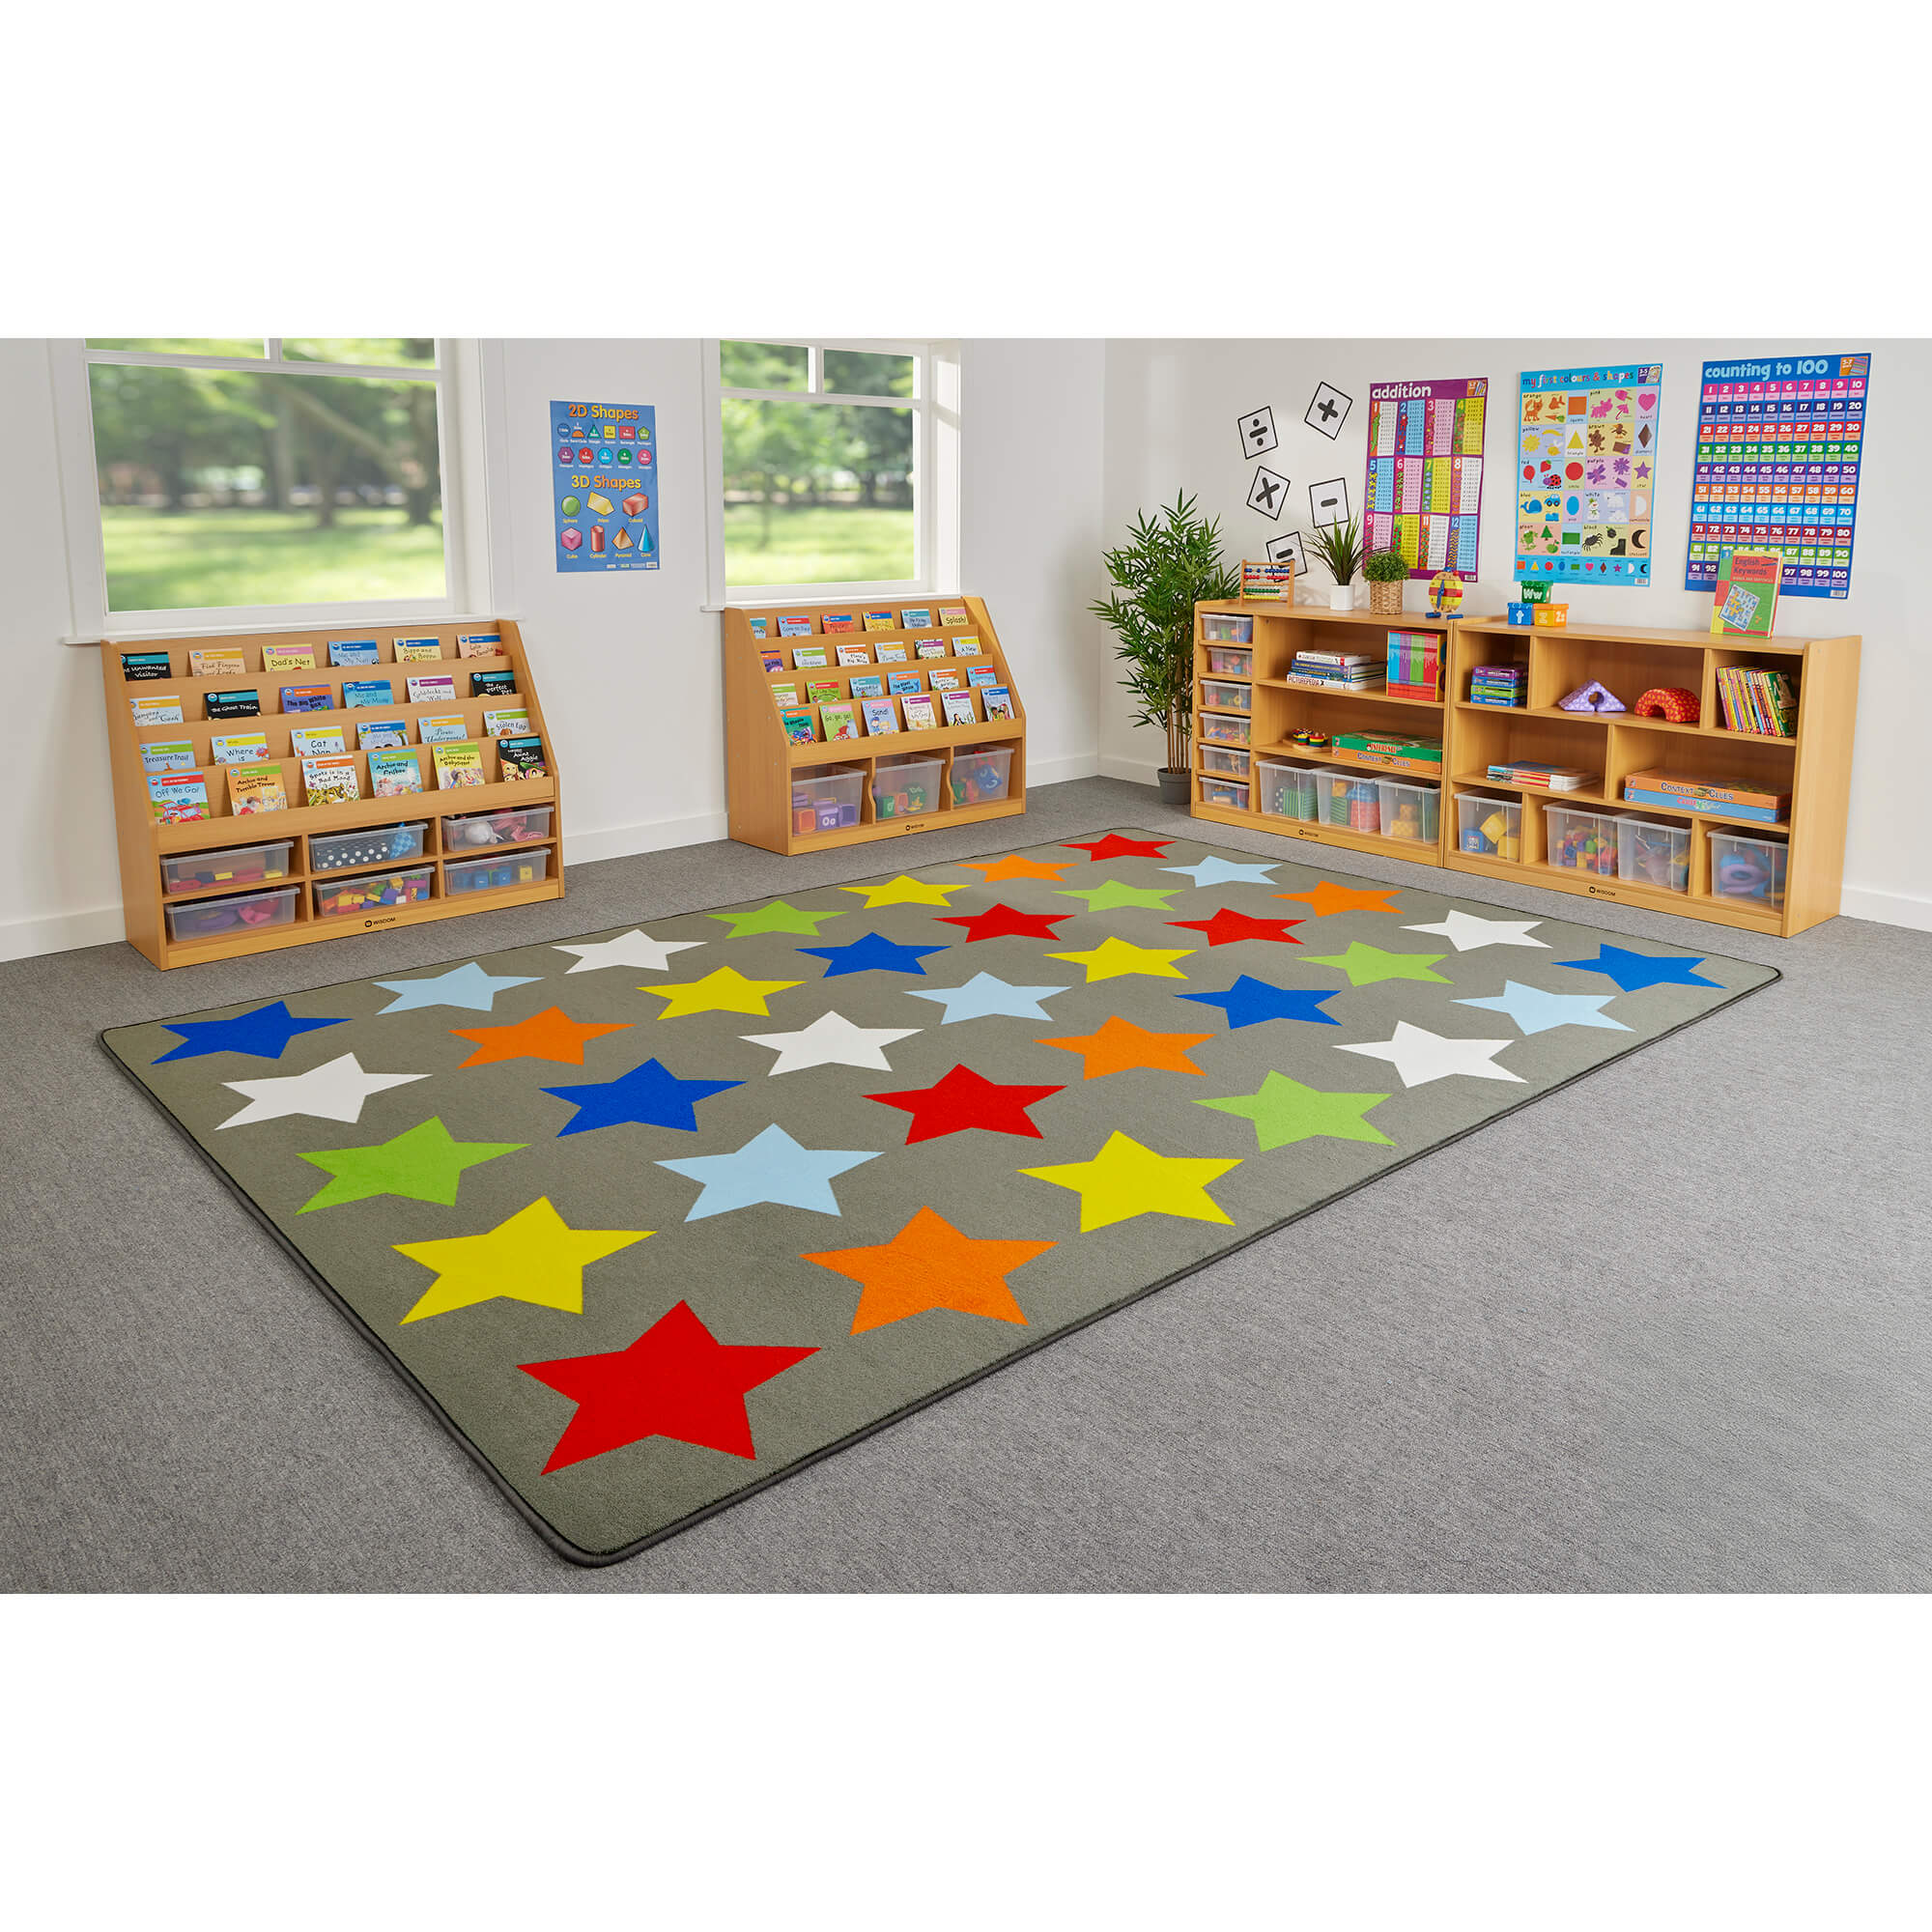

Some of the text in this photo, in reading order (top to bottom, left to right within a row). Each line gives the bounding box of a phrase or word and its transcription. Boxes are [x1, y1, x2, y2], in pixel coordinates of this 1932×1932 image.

[1705, 363, 1771, 381] counting
[1776, 362, 1792, 376] to
[1797, 359, 1829, 375] 100
[1522, 378, 1536, 388] my
[1538, 374, 1557, 388] first
[1560, 373, 1590, 384] colours
[1593, 372, 1600, 381] &
[1603, 370, 1634, 384] shapes
[1372, 383, 1432, 399] addition
[1708, 385, 1714, 394] 1
[1738, 384, 1745, 393] 3
[1770, 384, 1776, 392] 5
[1785, 383, 1793, 391] 6
[1836, 381, 1844, 389] 9
[1374, 402, 1378, 412] 1
[1401, 403, 1406, 412] 2
[1428, 401, 1434, 411] 3
[1458, 400, 1463, 410] 4
[1719, 405, 1729, 413] 12
[1735, 405, 1745, 413] 13
[1766, 404, 1776, 412] 15
[1800, 403, 1809, 412] 17
[1816, 402, 1826, 411] 18
[1833, 402, 1843, 411] 19
[1848, 401, 1862, 411] 20
[568, 404, 639, 422] 2D Shapes
[1717, 425, 1728, 434] 22
[1731, 425, 1744, 434] 23
[1747, 424, 1759, 433] 24
[1763, 424, 1776, 433] 25
[1779, 424, 1792, 433] 26
[1812, 423, 1826, 432] 28
[1829, 423, 1842, 432] 29
[1846, 423, 1861, 432] 30
[1701, 444, 1859, 454] 31 32 33 34 35 36 37 38 39 40
[1370, 460, 1377, 469] 5
[1397, 459, 1403, 469] 6
[1426, 460, 1433, 469] 7
[1454, 459, 1462, 469] 8
[1842, 466, 1856, 474] 50
[571, 475, 641, 492] 3D Shapes
[1758, 486, 1771, 495] 55
[1775, 486, 1787, 495] 56
[1791, 486, 1803, 495] 57
[1807, 486, 1820, 495] 58
[1824, 486, 1836, 495] 59
[1840, 486, 1855, 496] 60
[1725, 505, 1737, 514] 63
[1740, 505, 1753, 514] 64
[1756, 506, 1769, 515] 65
[1772, 506, 1785, 515] 66
[1789, 506, 1802, 515] 67
[1822, 507, 1835, 516] 69
[1366, 515, 1373, 525] 9
[1423, 516, 1429, 526] 11
[1451, 517, 1459, 527] 12
[1709, 525, 1720, 533] 72
[1724, 526, 1735, 534] 73
[1740, 526, 1750, 534] 74
[1755, 526, 1767, 535] 75
[1772, 526, 1783, 535] 76
[1804, 527, 1816, 536] 78
[1836, 528, 1851, 537] 80
[1705, 564, 1717, 573] 92
[1816, 569, 1830, 578] 99
[1832, 570, 1848, 579] 100
[1733, 567, 1768, 576] Keywords
[1523, 588, 1543, 600] Ww
[270, 658, 293, 667] Dad's
[1287, 674, 1320, 686] PICTUREPEDIA
[311, 740, 327, 749] Cat
[1371, 742, 1397, 753] INFERENCE
[226, 748, 254, 757] Where
[145, 753, 189, 764] Treasure Trail
[1357, 752, 1410, 767] CONTEXT CLUES
[376, 761, 395, 770] Archie
[156, 787, 169, 799] Off
[170, 786, 183, 796] We
[1661, 781, 1734, 801] CONTEXT CLUES
[373, 917, 396, 925] WISDOM
